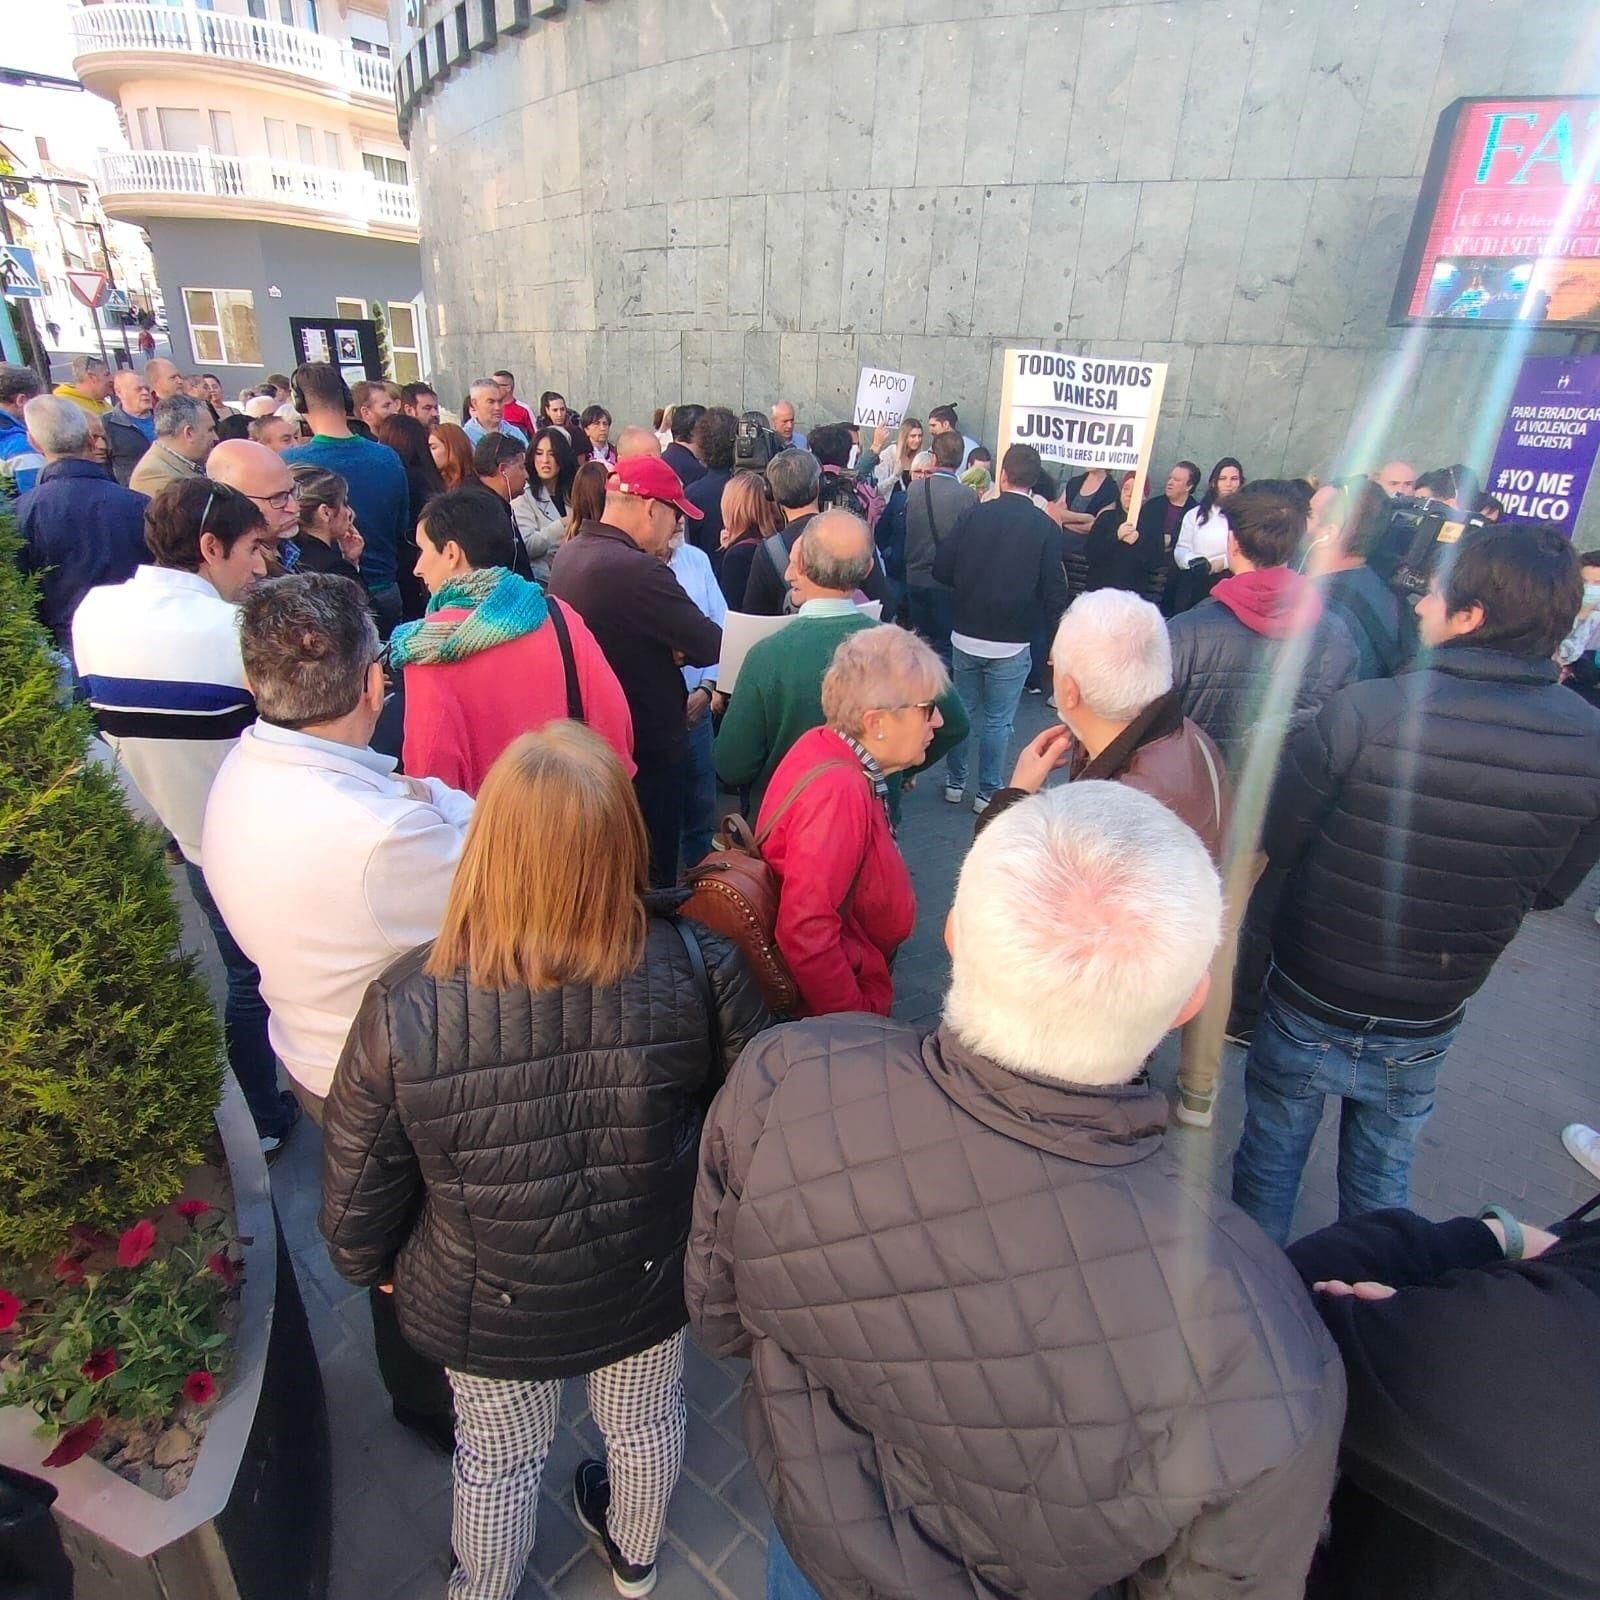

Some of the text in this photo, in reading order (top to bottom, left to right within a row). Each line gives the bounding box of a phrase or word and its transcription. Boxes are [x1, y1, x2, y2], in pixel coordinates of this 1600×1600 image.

[1018, 354, 1153, 388] TODOS SOMOS
[869, 373, 907, 393] APOYO
[885, 395, 891, 405] A
[1053, 381, 1118, 411] VANESA
[1511, 405, 1538, 418] PARA
[1016, 414, 1134, 448] JUSTICIA
[1514, 420, 1588, 436] LA VIOLENCIA
[1516, 434, 1573, 450] MACHISTA
[1074, 448, 1093, 461] ERES
[1095, 450, 1106, 462] LA
[1497, 469, 1575, 496] #YO ME
[1491, 491, 1570, 521] MPLICO
